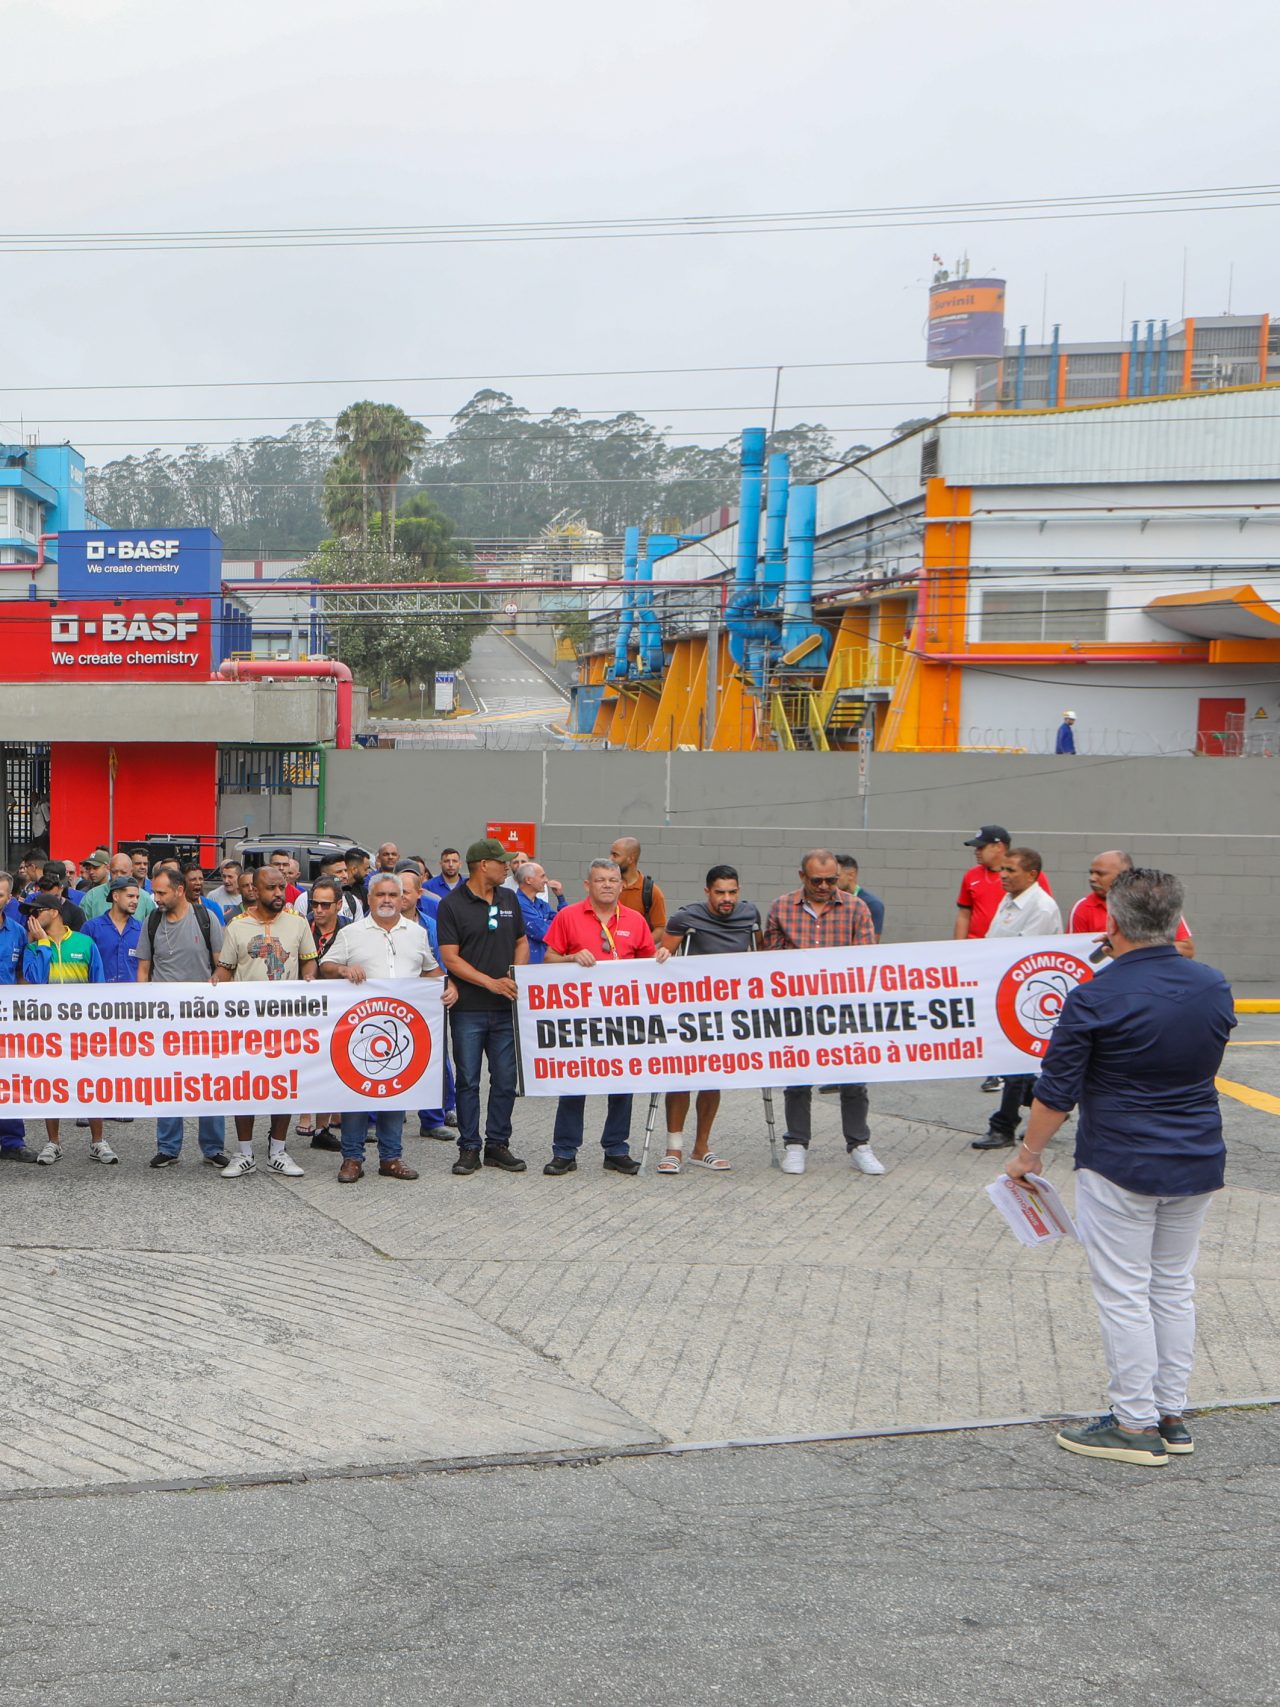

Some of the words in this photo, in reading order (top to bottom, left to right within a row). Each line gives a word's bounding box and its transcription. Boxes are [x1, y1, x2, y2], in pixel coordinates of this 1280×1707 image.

[119, 540, 179, 558] BASF
[135, 564, 179, 573] chemistry
[103, 613, 198, 640] BASF
[52, 652, 74, 664] We
[79, 653, 122, 664] create
[127, 651, 198, 665] chemistry
[1012, 956, 1085, 981] QUÍMICOS
[529, 982, 592, 1010] BASF
[599, 980, 639, 1007] vai
[646, 976, 741, 1004] vender
[748, 977, 764, 998] a
[771, 965, 977, 997] Suvinil/Glasu...
[12, 997, 51, 1021] Não
[57, 1002, 83, 1021] se
[88, 1001, 175, 1022] compra,
[180, 996, 219, 1019] não
[224, 1000, 250, 1018] se
[254, 995, 328, 1018] vende!
[348, 1000, 414, 1024] QUÍMICOS
[537, 1012, 723, 1048] DEFENDA-SE!
[732, 999, 974, 1039] SINDICALIZE-SE!
[71, 1027, 154, 1060] pelos
[163, 1029, 319, 1058] empregos
[535, 1057, 623, 1079] Direitos
[630, 1058, 642, 1075] e
[649, 1052, 763, 1075] empregos
[769, 1046, 810, 1068] não
[817, 1042, 881, 1066] estão
[887, 1044, 901, 1062] à
[907, 1037, 982, 1062] venda!
[77, 1070, 297, 1105] conquistados!
